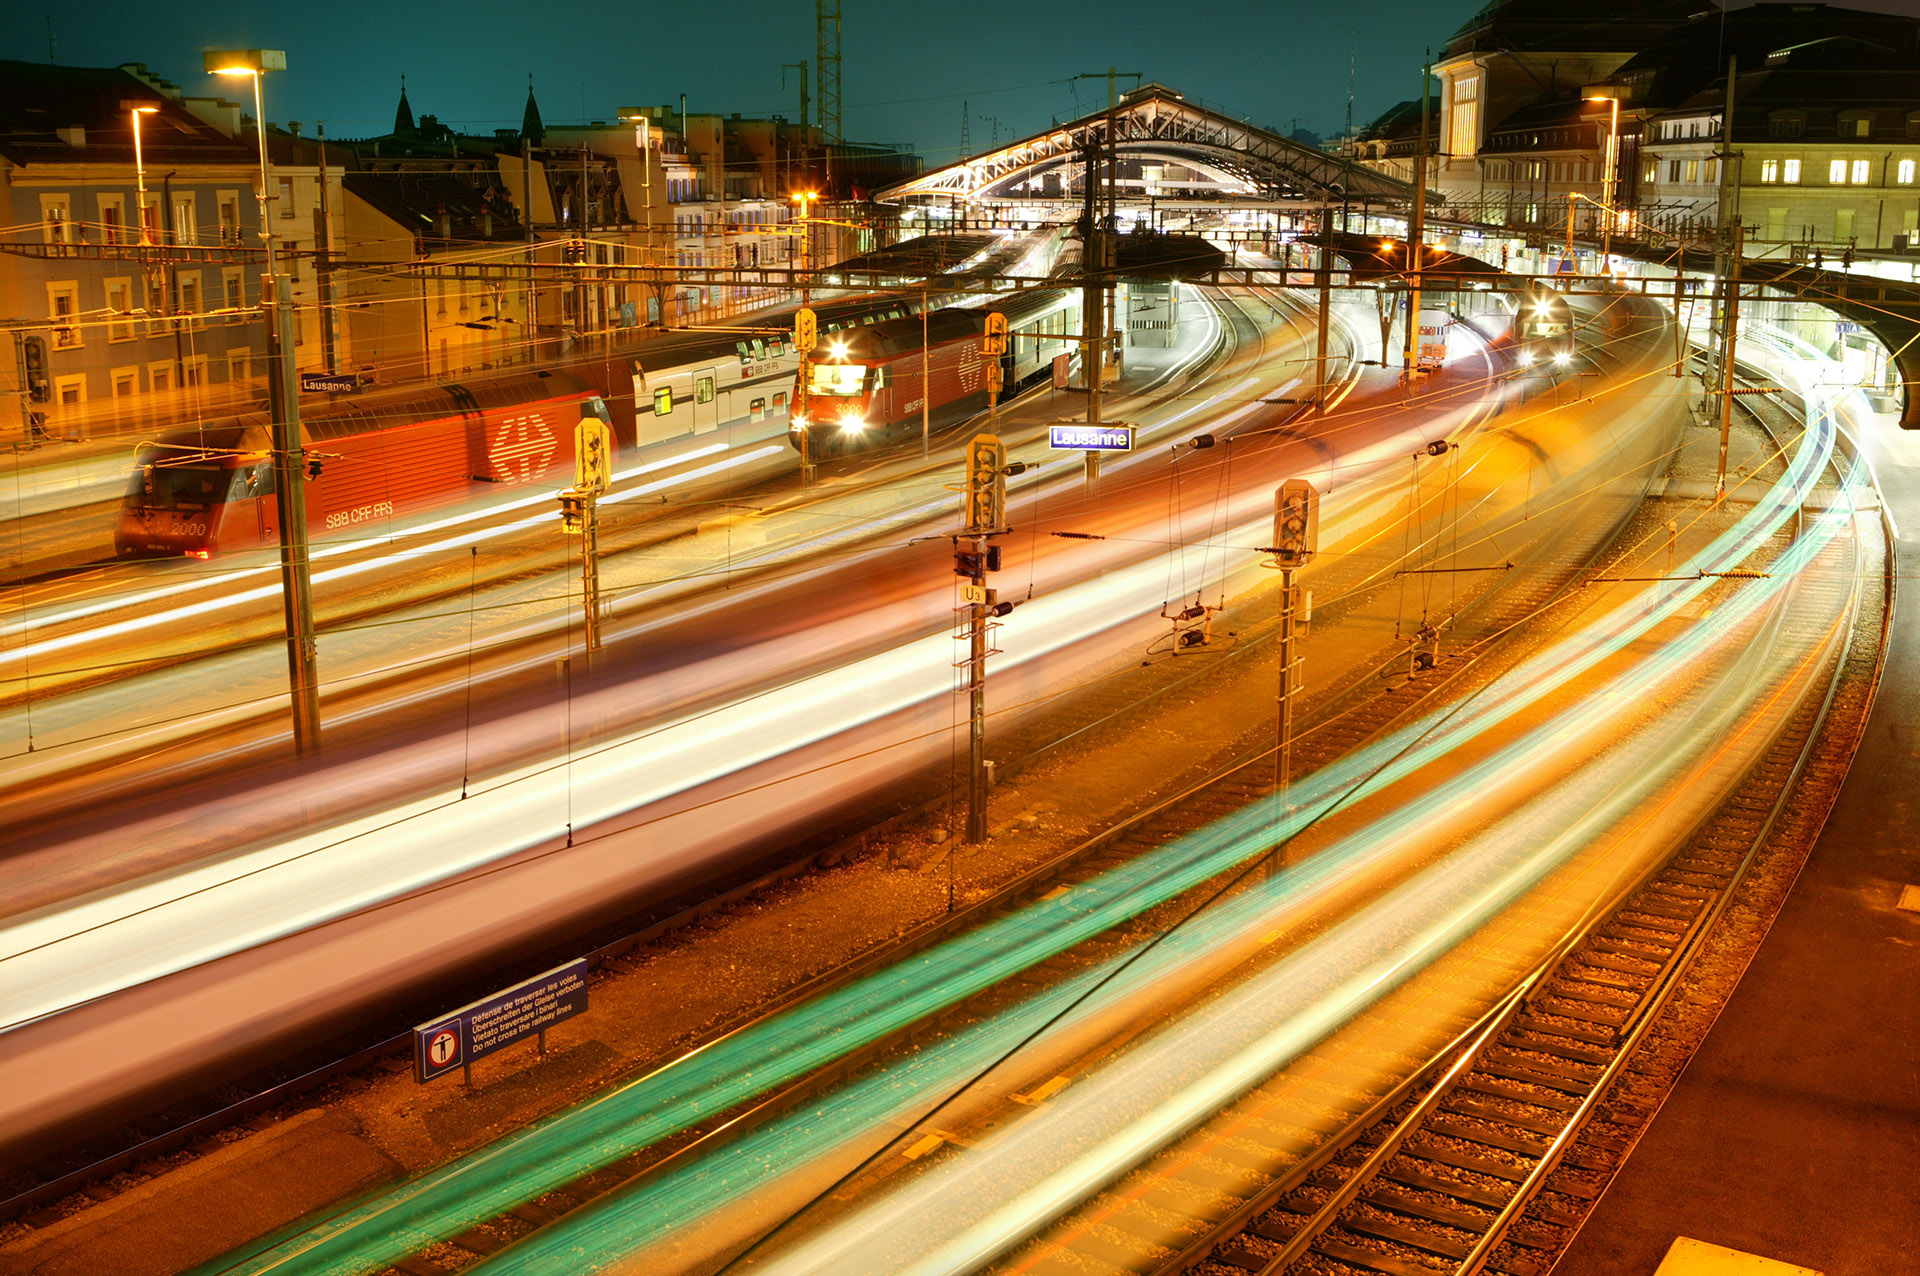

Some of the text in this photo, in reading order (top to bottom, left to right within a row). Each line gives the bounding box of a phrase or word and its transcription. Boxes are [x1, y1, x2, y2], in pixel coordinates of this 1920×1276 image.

[1527, 233, 1542, 246] 63
[1650, 236, 1664, 249] 62
[1794, 249, 1806, 260] 61
[303, 379, 352, 391] Lausanne
[836, 403, 862, 413] 2000
[1053, 428, 1127, 446] Lausanne
[326, 501, 393, 529] SBB CFF FFS
[170, 523, 206, 536] 2000
[471, 973, 578, 1025] Défense de traverser les voies
[472, 979, 584, 1034] Überschreiten der Gleise verboten
[472, 1026, 498, 1043] Vietato
[499, 1010, 535, 1032] traversare
[539, 1000, 558, 1014] binari
[472, 1003, 573, 1053] Do not cross the railway lines
